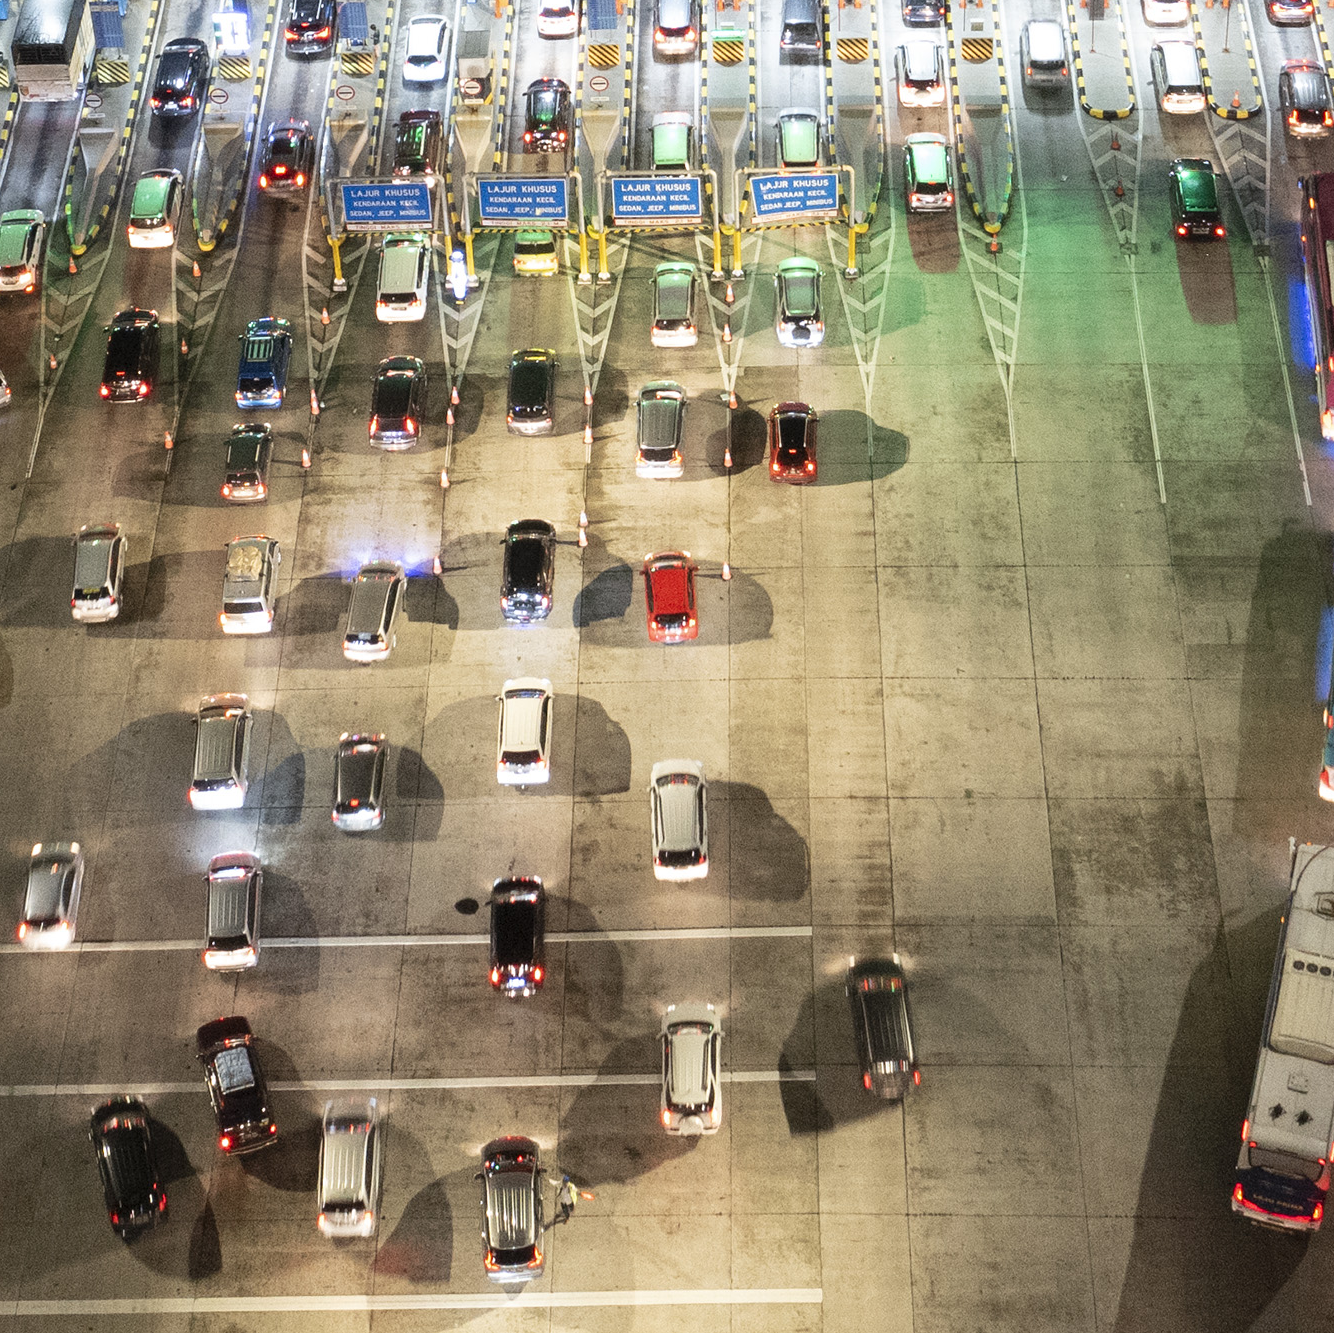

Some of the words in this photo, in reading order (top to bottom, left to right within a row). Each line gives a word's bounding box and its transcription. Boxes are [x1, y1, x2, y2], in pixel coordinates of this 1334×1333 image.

[793, 179, 829, 188] KHUSUS
[351, 189, 380, 197] LAJUR
[385, 188, 420, 196] KHUSUS
[522, 185, 557, 193] KHUSUS
